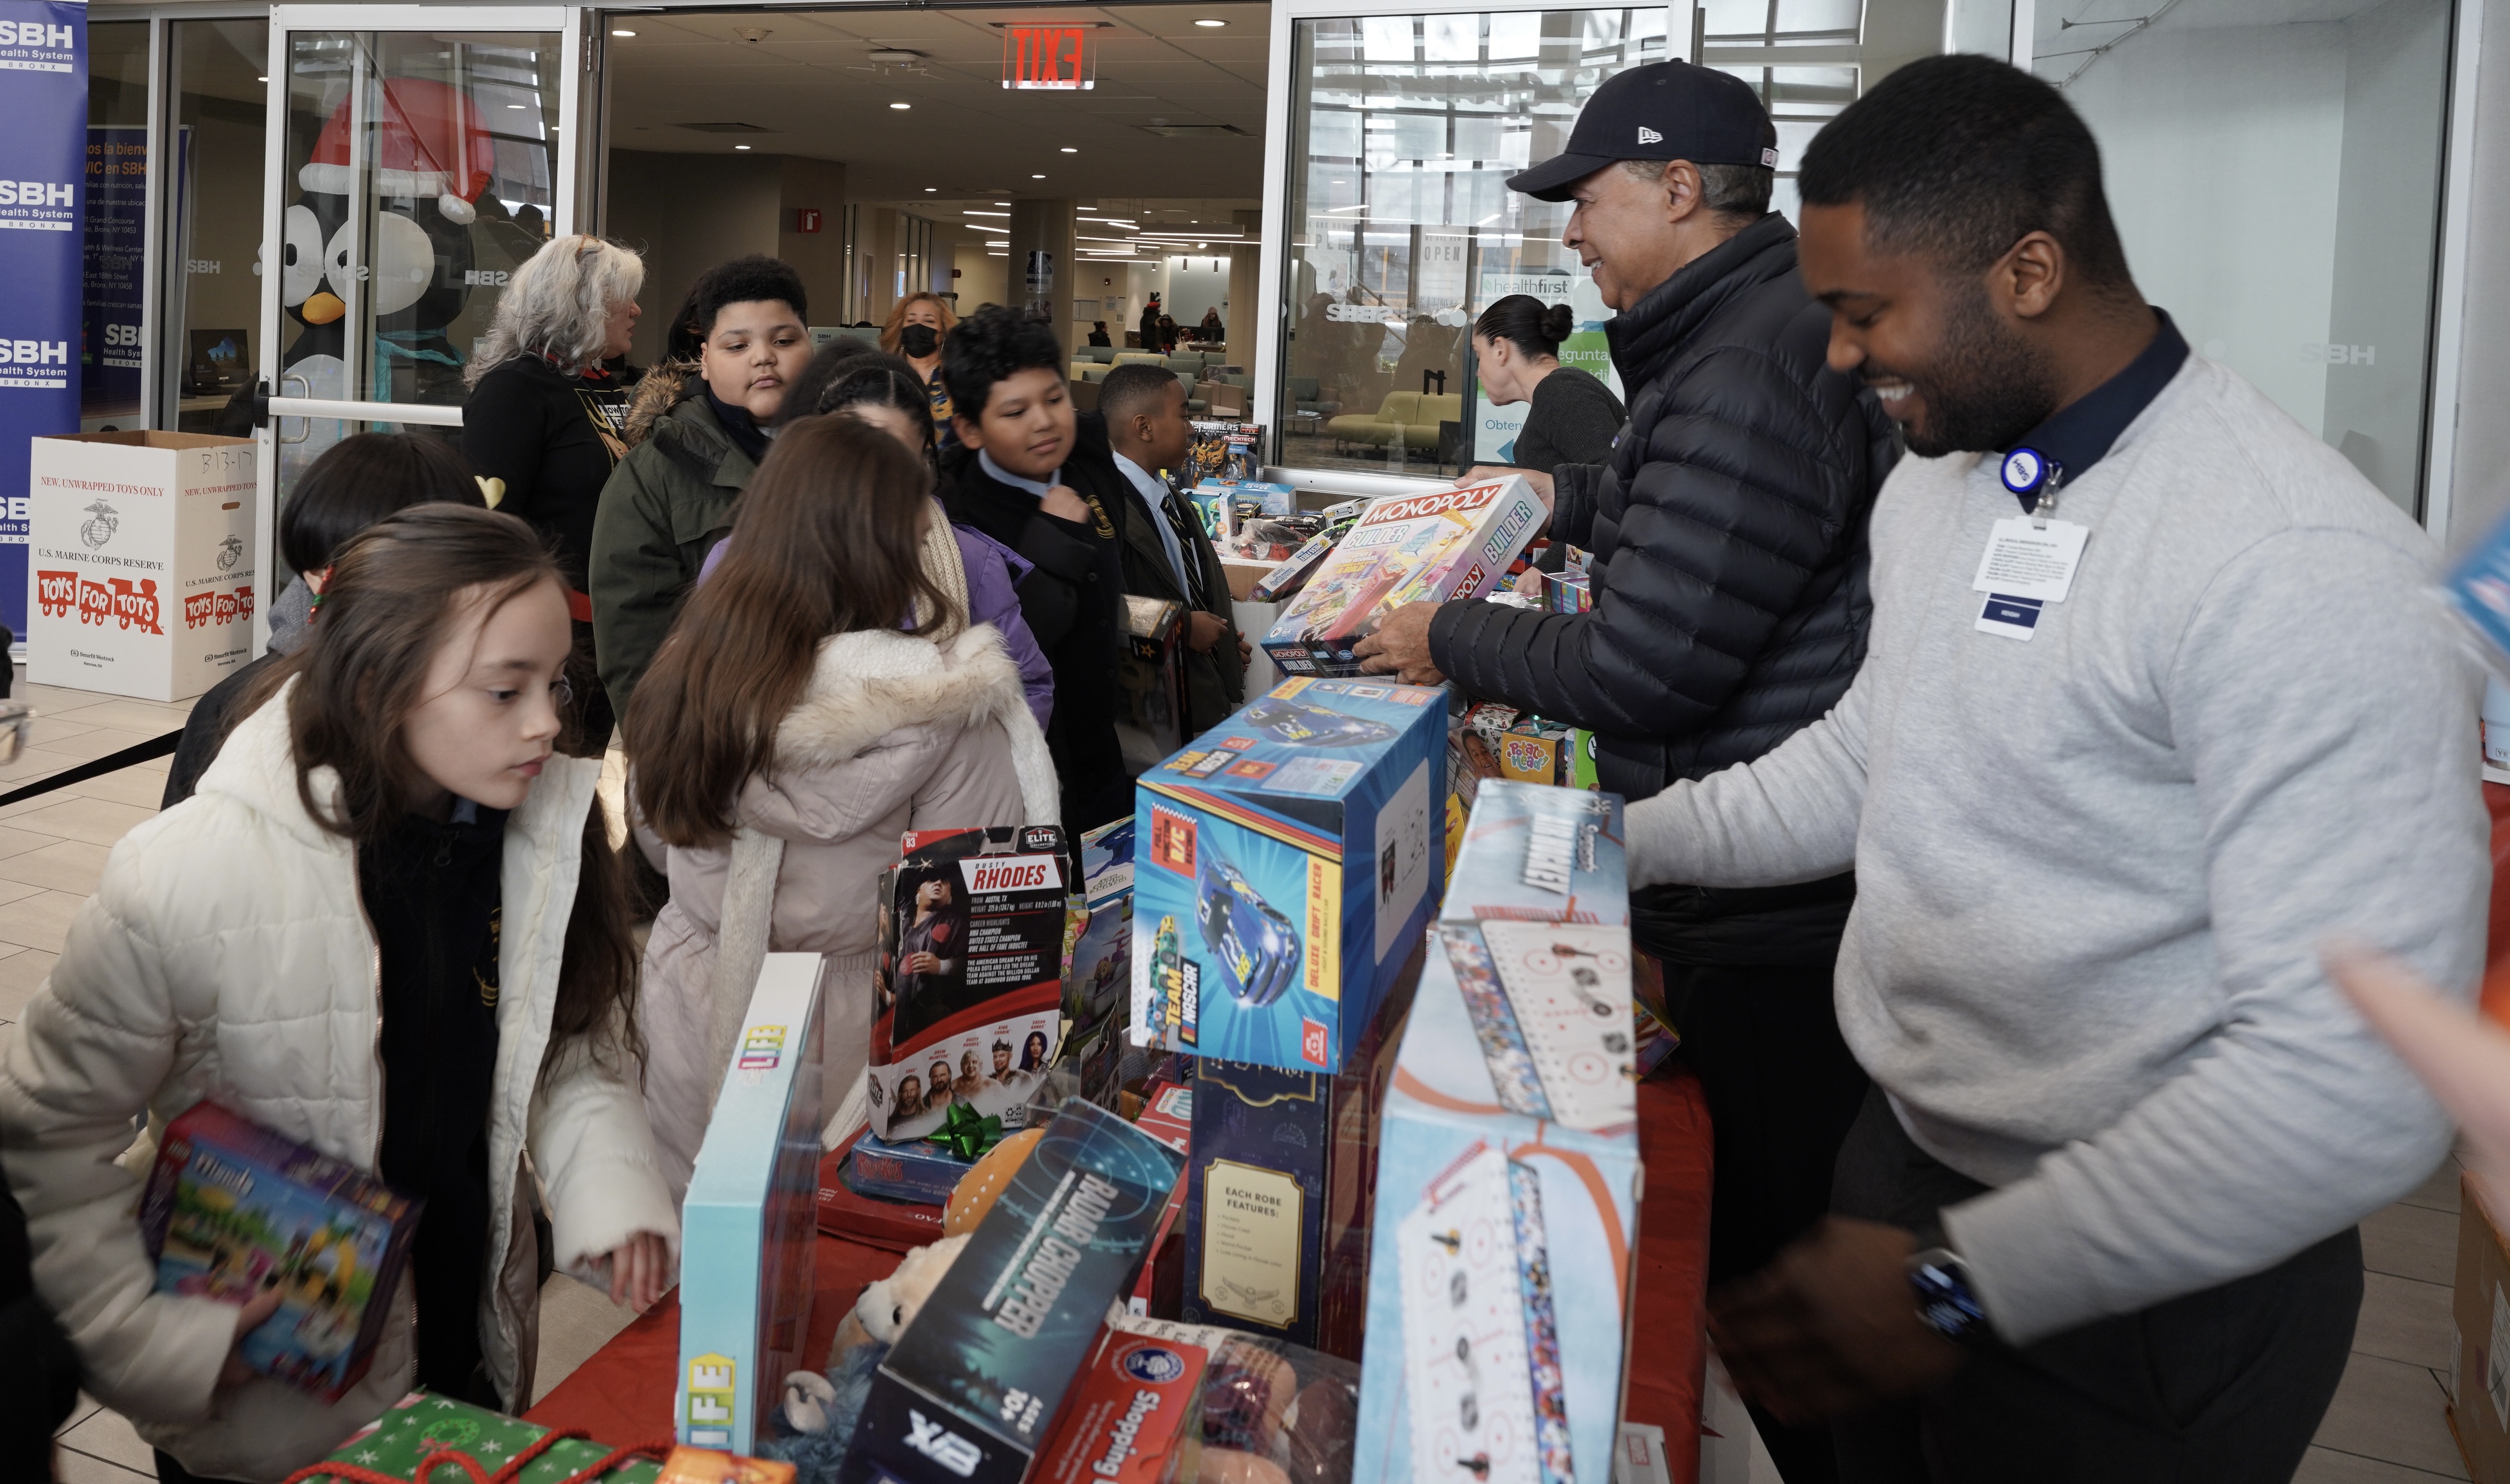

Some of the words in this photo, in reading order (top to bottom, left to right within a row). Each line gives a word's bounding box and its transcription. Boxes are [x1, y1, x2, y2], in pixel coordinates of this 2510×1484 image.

[0, 20, 73, 49] SBH
[32, 50, 73, 60] System
[104, 142, 114, 155] la
[105, 164, 119, 174] en
[0, 180, 74, 207] SBH
[32, 209, 73, 219] System
[1424, 246, 1460, 261] OPEN
[187, 259, 220, 274] SBH
[1494, 279, 1568, 294] healthfirst
[0, 338, 67, 364] SBH
[104, 348, 125, 356] Health
[2299, 342, 2376, 366] SBH
[27, 367, 67, 376] System
[41, 477, 61, 488] NEW,
[62, 479, 115, 492] UNWRAPPED
[116, 483, 138, 495] TOYS
[140, 486, 164, 497] ONLY
[184, 487, 202, 496] NEW,
[203, 483, 242, 495] UNWRAPPED
[243, 481, 257, 490] TOYS
[1365, 487, 1499, 524] MONOPOLY
[1344, 524, 1410, 549] BUILDER
[1482, 501, 1533, 566] BUILDER
[1299, 550, 1311, 562] FREE
[1309, 543, 1322, 554] MESS
[38, 549, 53, 558] U.S.
[55, 551, 90, 562] MARINE
[92, 554, 121, 566] CORPS
[124, 559, 164, 570] RESERVE
[198, 575, 223, 585] MARINE
[224, 571, 244, 580] CORPS
[1272, 568, 1285, 577] Stamper
[41, 577, 74, 601] TOYS
[81, 585, 108, 611] FOR
[117, 594, 154, 622] TOTS
[187, 596, 212, 617] TOYS
[216, 599, 235, 613] FOR
[1274, 649, 1307, 658] MONOPOLY
[1282, 660, 1317, 671] BUILDER
[906, 837, 916, 848] 83
[1027, 833, 1054, 842] ELITE
[1170, 826, 1186, 864] R/C
[975, 861, 1006, 869] DUSTY
[973, 864, 1046, 890] RHODES
[1313, 862, 1322, 900] RACER
[985, 895, 1001, 904] AUSTIN,
[979, 928, 1002, 936] CHAMPION
[986, 918, 1010, 926] HIGHLIGHTS
[1311, 905, 1321, 939] DRIFT
[968, 937, 984, 945] UNITED
[999, 934, 1021, 942] CHAMPION
[1008, 941, 1028, 949] INDUCTEE
[1310, 943, 1320, 988] DELUXE
[1165, 967, 1182, 1026] TEAM
[1182, 963, 1197, 1025] NASCAR
[741, 1028, 785, 1068] LIFE
[870, 1080, 882, 1101] ELITE
[1226, 1187, 1251, 1199] EACH
[1255, 1193, 1282, 1207] ROBE
[1053, 1173, 1119, 1244] RADAR
[1227, 1199, 1278, 1218] FEATURES:
[993, 1236, 1082, 1340] CHOPPER
[1000, 1386, 1029, 1421] 10+
[1092, 1389, 1161, 1477] Shopping
